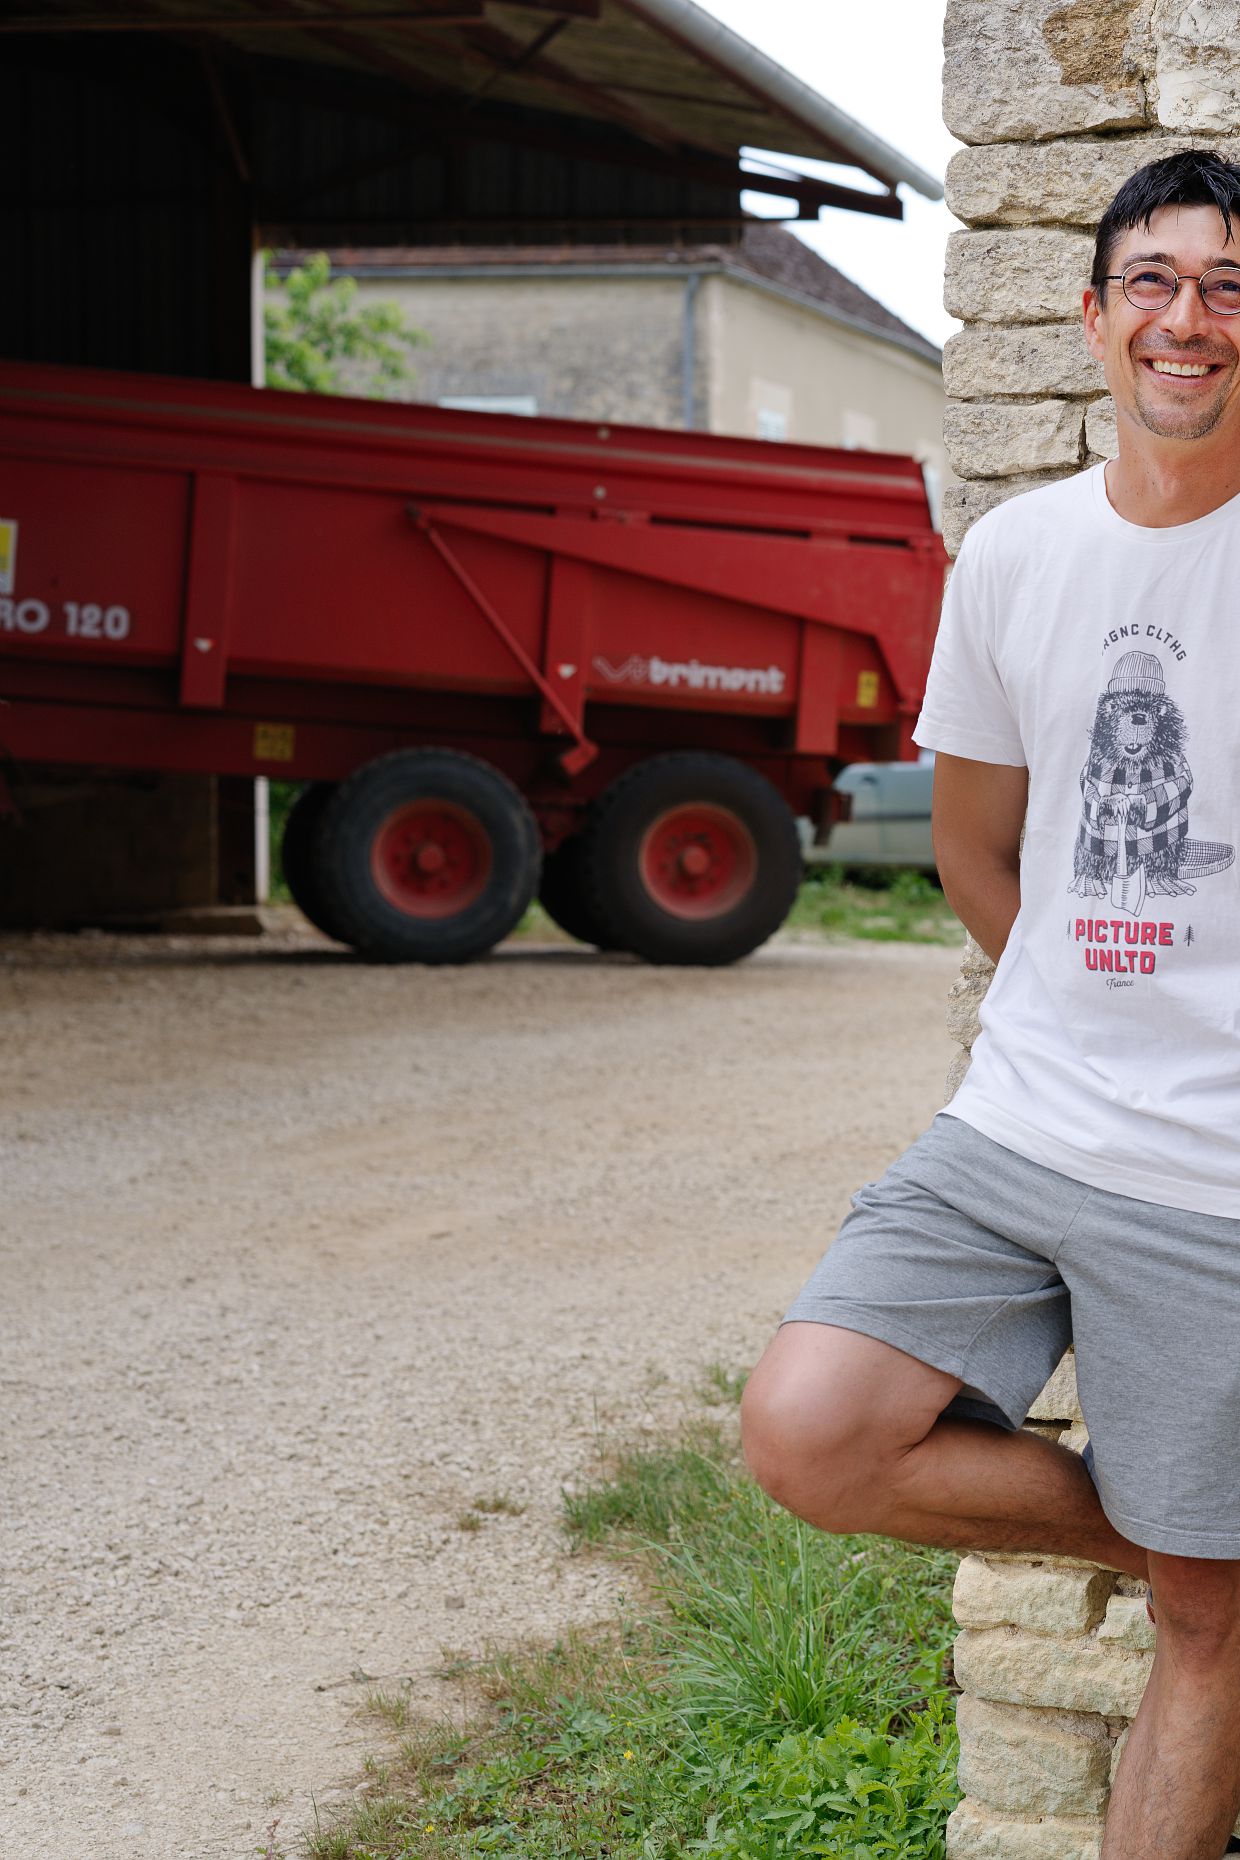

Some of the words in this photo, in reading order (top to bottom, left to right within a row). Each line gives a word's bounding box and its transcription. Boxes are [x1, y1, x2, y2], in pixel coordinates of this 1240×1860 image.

[64, 601, 129, 639] 120
[1147, 625, 1187, 661] CLTHG
[1075, 918, 1175, 946] PICTURE
[1085, 948, 1156, 975] UNLTD
[1106, 978, 1135, 990] France
